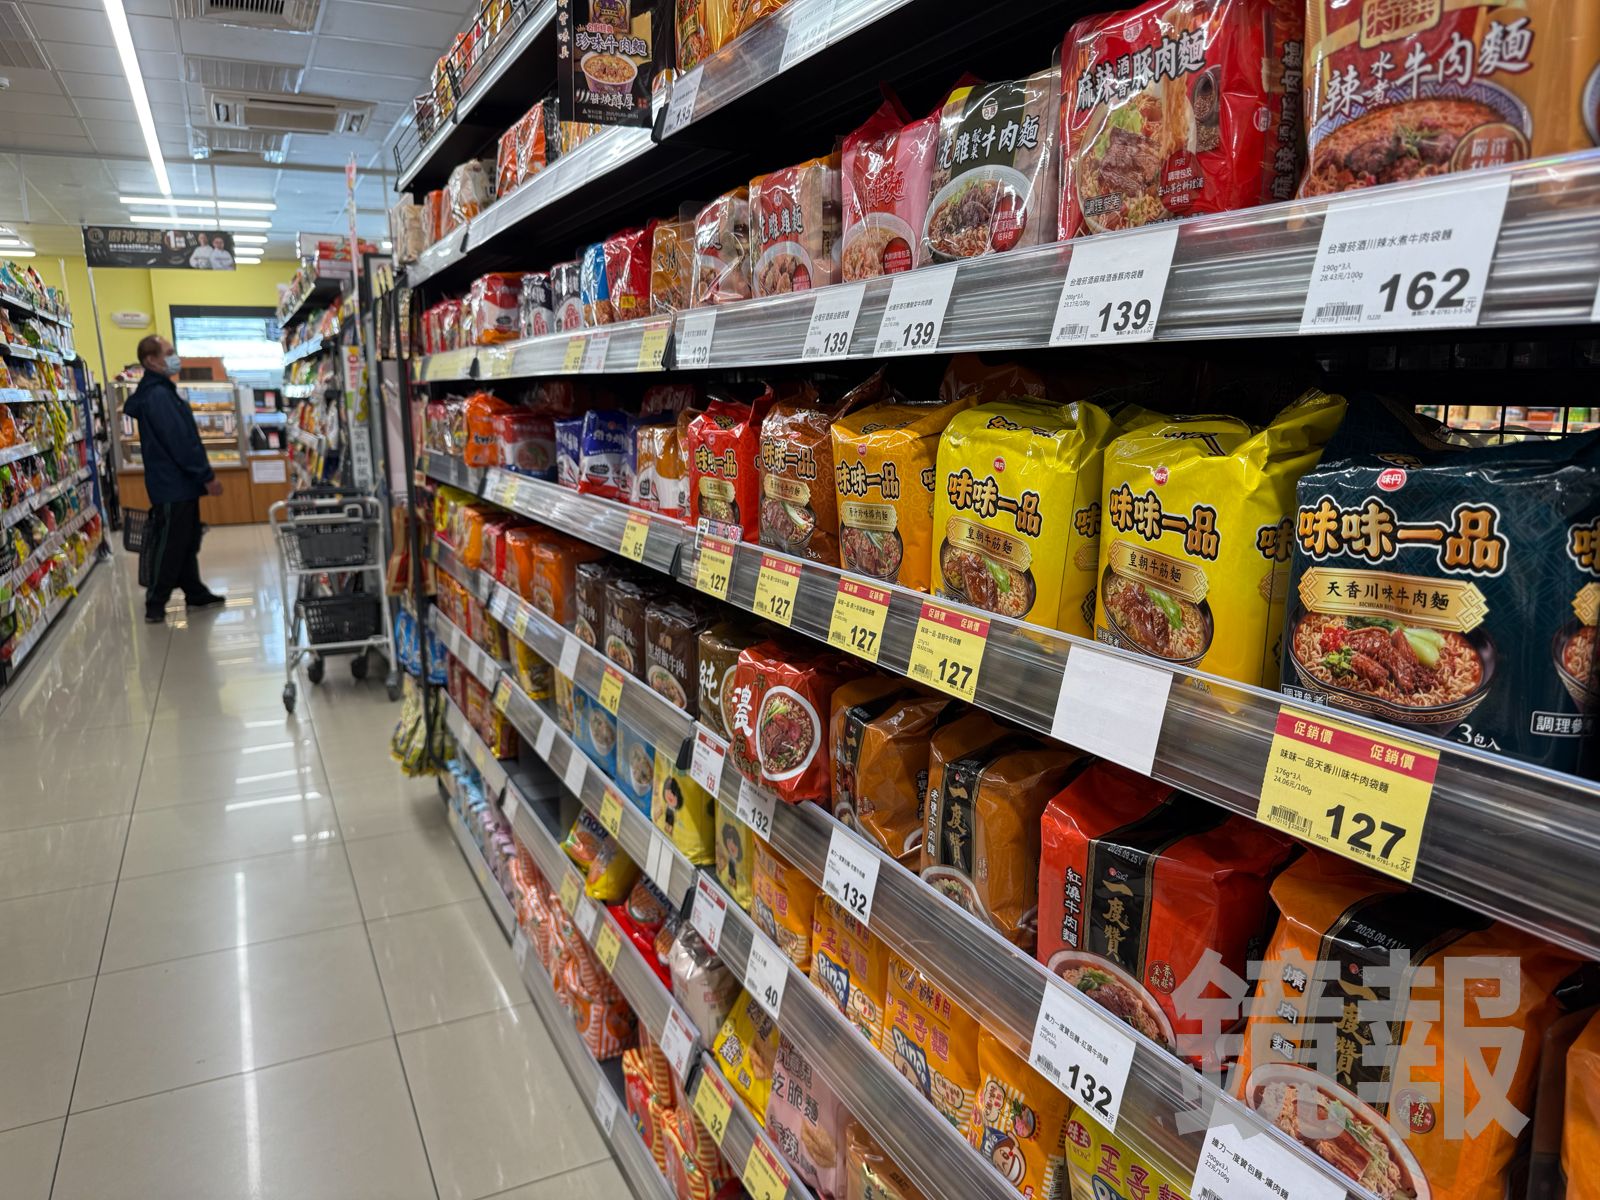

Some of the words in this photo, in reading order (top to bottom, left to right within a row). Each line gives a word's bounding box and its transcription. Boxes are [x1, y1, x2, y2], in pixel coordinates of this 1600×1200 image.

[576, 32, 647, 56] 珍味牛肉麵
[1076, 28, 1206, 112] 麻辣酒香豚肉麵
[1327, 229, 1453, 255] 台灣菸酒川辣水煮牛肉袋麵
[1379, 268, 1470, 313] 162
[1098, 299, 1152, 333] 139
[824, 331, 848, 353] 139
[903, 321, 935, 347] 139
[695, 446, 738, 478] 味味一品
[762, 438, 816, 480] 味味一品
[836, 460, 901, 500] 味味一品
[1381, 472, 1402, 486] 味丹
[948, 468, 1043, 538] 味味一品
[1109, 482, 1221, 562] 味味一品
[1297, 495, 1509, 578] 味味一品
[633, 542, 642, 557] 65
[966, 526, 1013, 554] 皇朝牛筋麵
[709, 572, 727, 592] 127
[1128, 551, 1182, 583] 皇朝牛筋麵
[769, 595, 791, 617] 127
[1327, 580, 1450, 612] 天香川味牛肉麵
[850, 625, 877, 651] 127
[938, 657, 973, 690] 127
[732, 684, 754, 737] 濃
[1293, 720, 1333, 745] 促銷價
[1370, 743, 1416, 770] 促銷價
[1456, 723, 1501, 750] 3包入
[1273, 775, 1313, 796] 24.06元/100g
[1280, 748, 1390, 794] 味味一品天香川味牛肉袋麵
[750, 807, 769, 834] 132
[947, 786, 968, 869] 一度贊
[1326, 804, 1407, 860] 127
[1401, 856, 1411, 869] 元
[842, 882, 868, 917] 132
[1061, 867, 1083, 948] 紅燒牛肉麵
[1102, 879, 1134, 964] 一度贊
[764, 985, 778, 1008] 40
[894, 1000, 949, 1063] 王子麵
[1334, 977, 1380, 1086] 一度贊
[1068, 1063, 1113, 1118] 132
[710, 1114, 723, 1136] 32
[1066, 1121, 1091, 1149] 味王
[1204, 1159, 1230, 1184] 22元/100g
